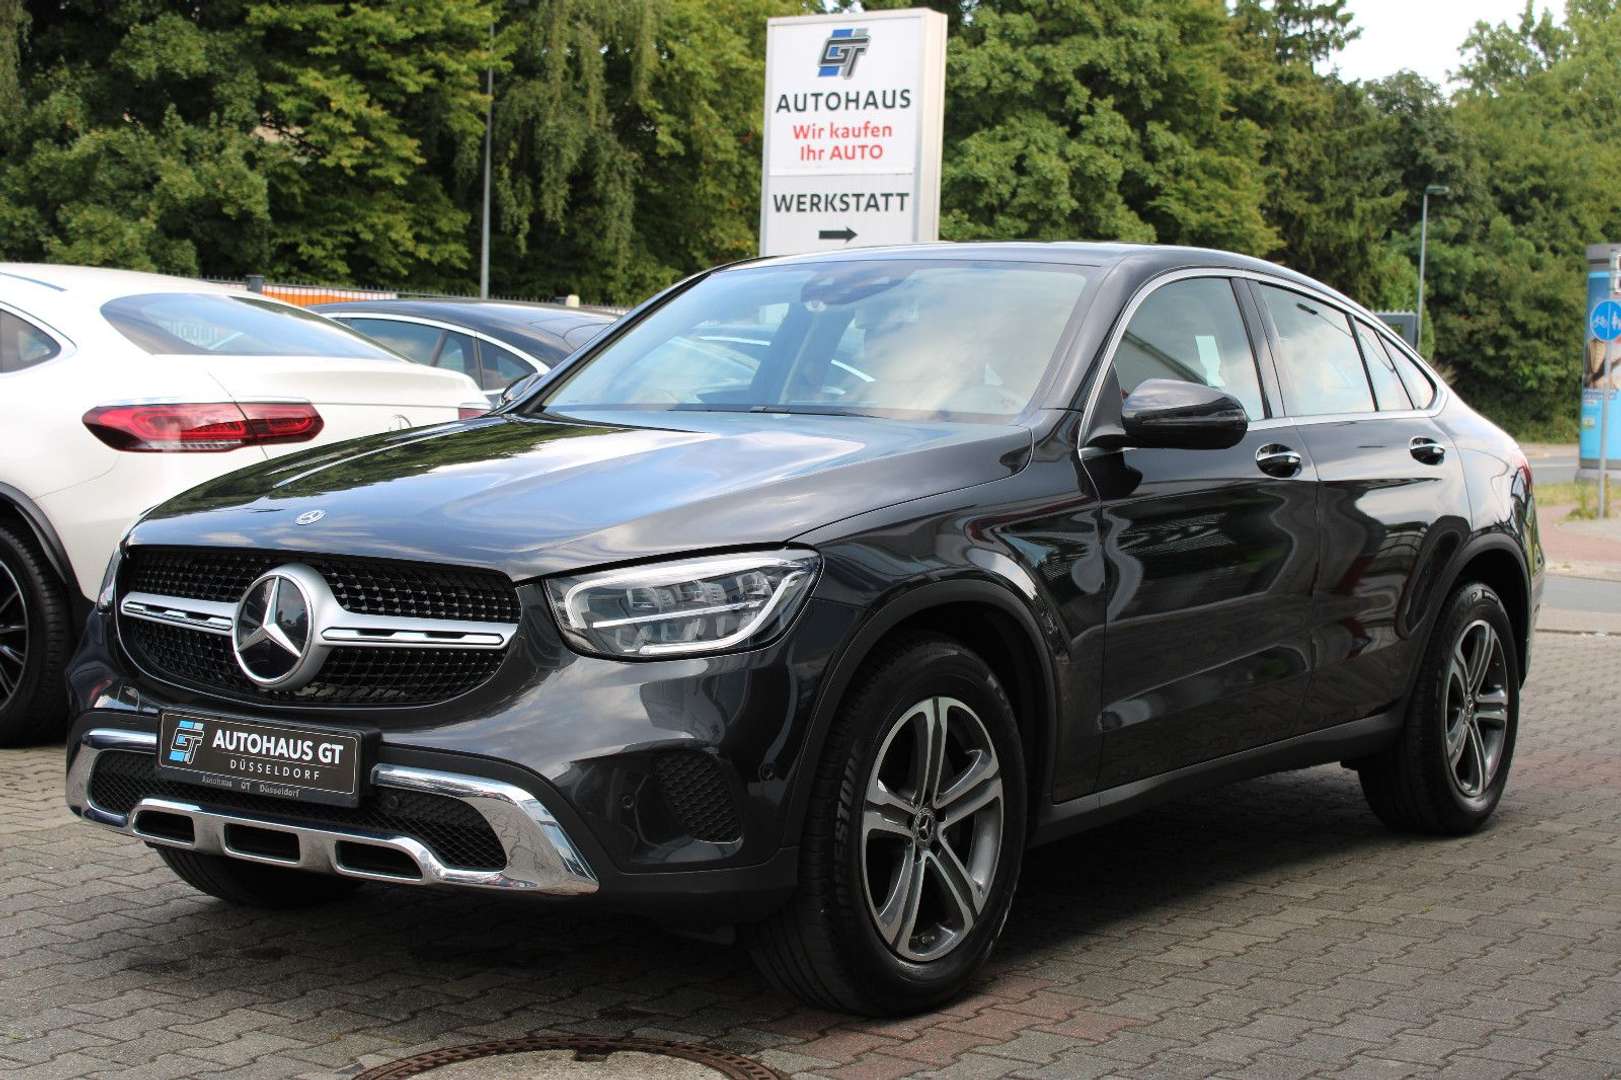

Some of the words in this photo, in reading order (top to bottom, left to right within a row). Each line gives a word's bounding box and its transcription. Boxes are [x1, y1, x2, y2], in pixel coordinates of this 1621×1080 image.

[775, 89, 911, 113] AUTOHAUS
[793, 124, 824, 140] Wir
[830, 122, 892, 139] kaufen
[800, 144, 825, 161] Ihr
[829, 144, 884, 160] AUTO
[773, 193, 909, 213] WERKSTATT
[212, 730, 314, 761] AUTOHAUS
[318, 743, 344, 764] GT
[230, 759, 321, 781] DÜSSELDORF
